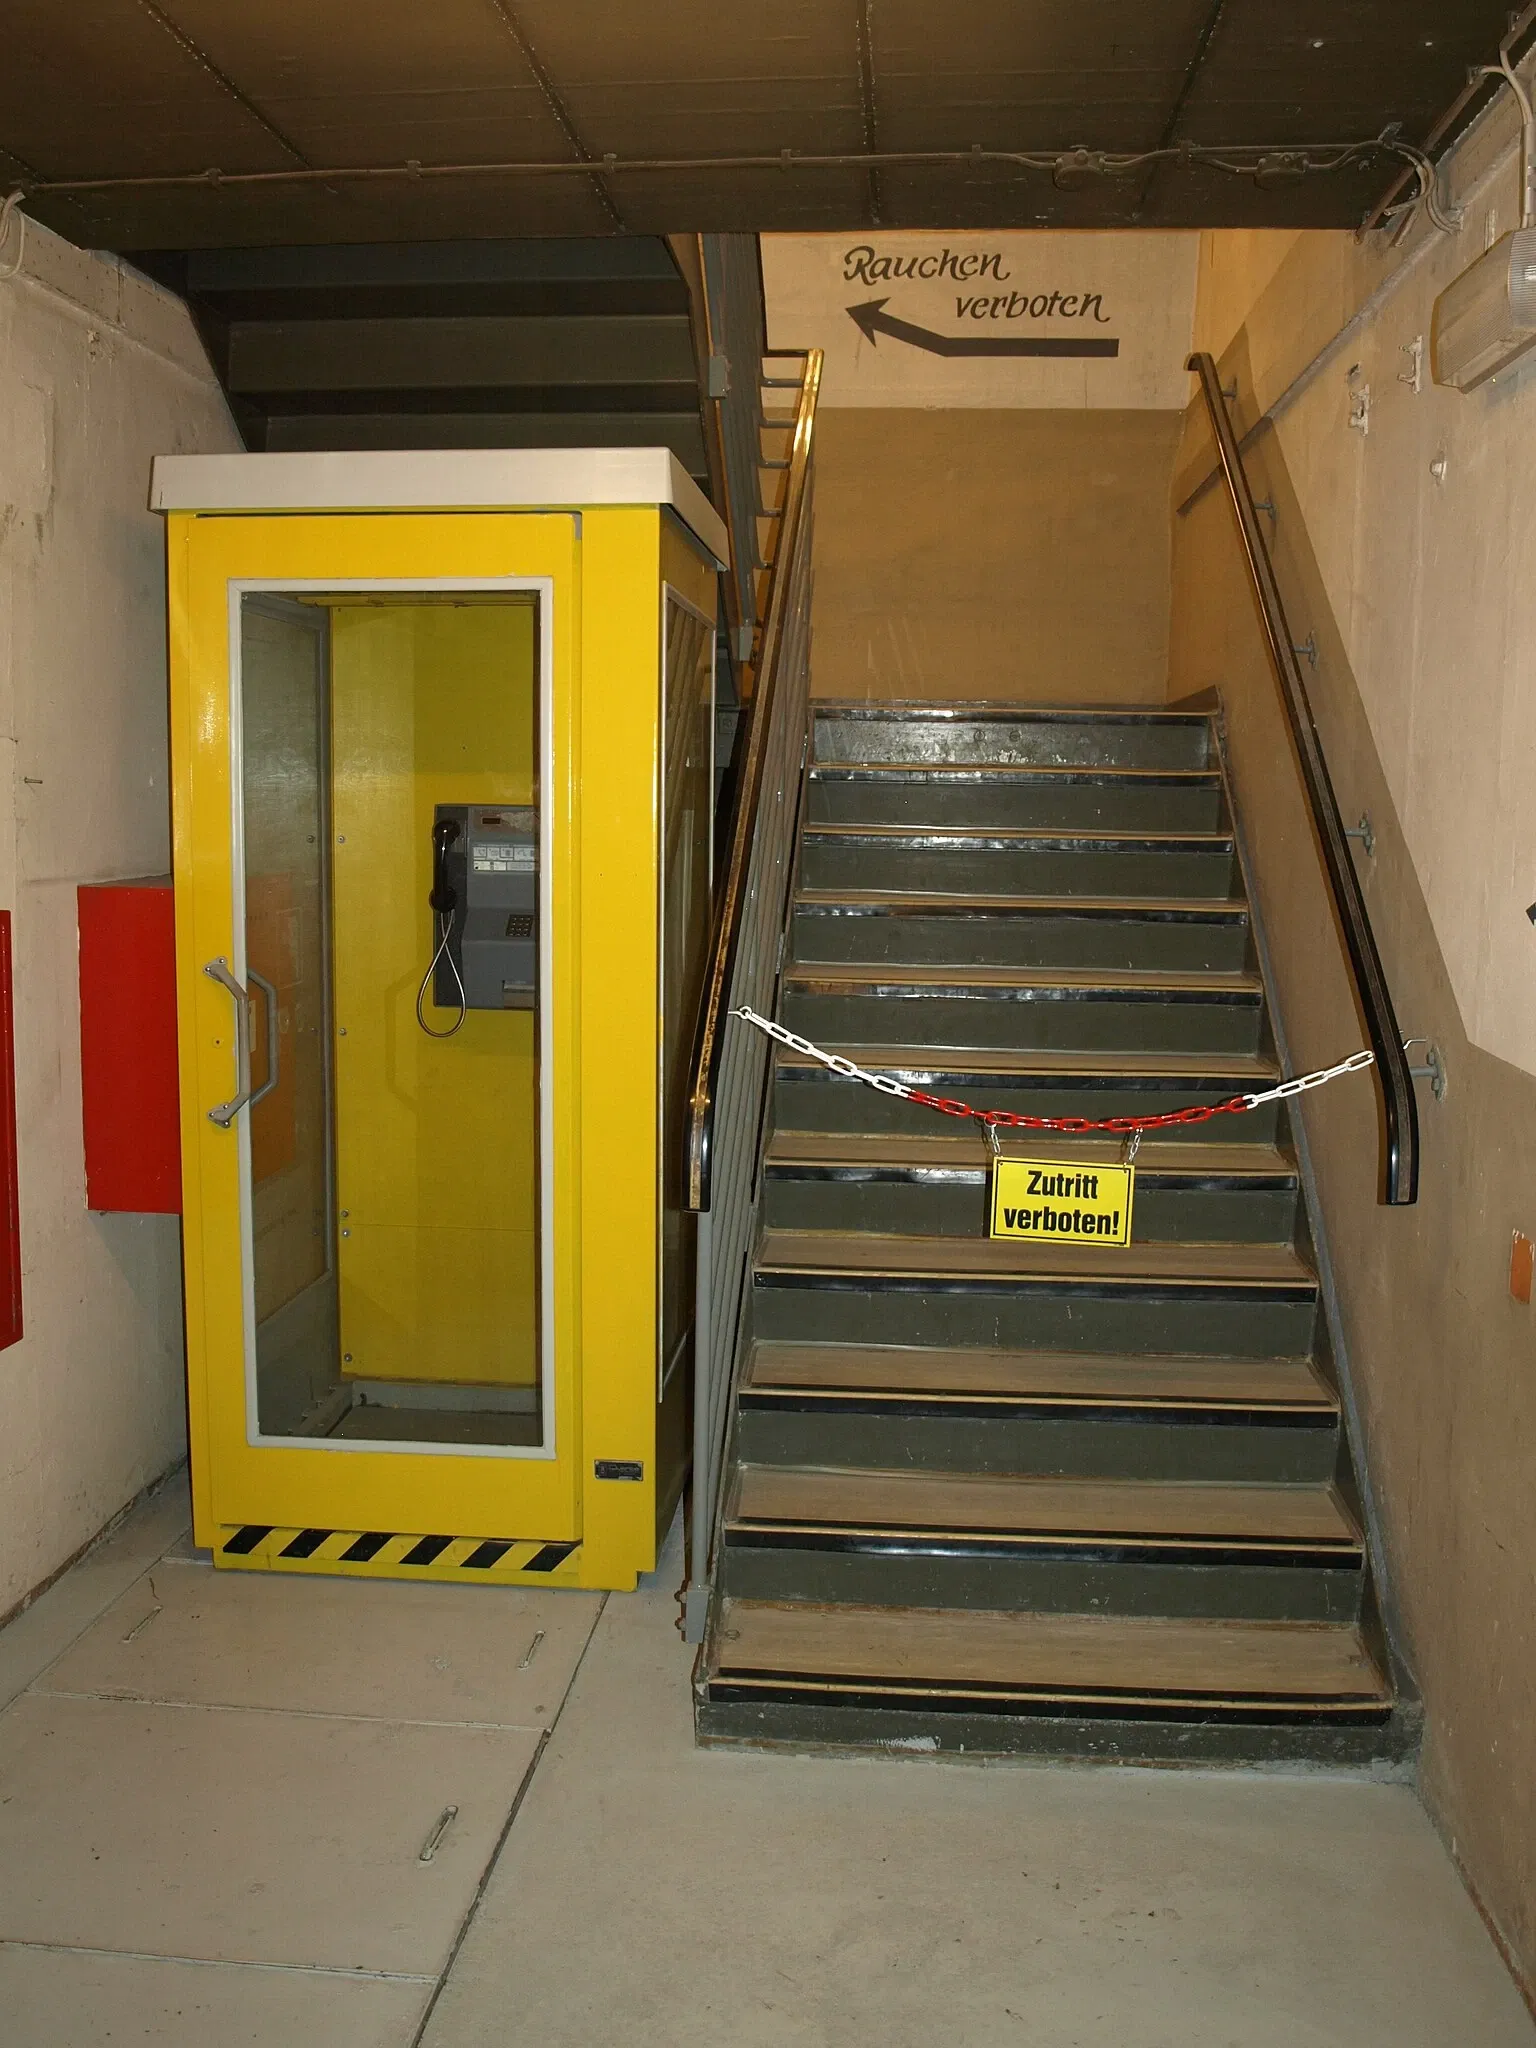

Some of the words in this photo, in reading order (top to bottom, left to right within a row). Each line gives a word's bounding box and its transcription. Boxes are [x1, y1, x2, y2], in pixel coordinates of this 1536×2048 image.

[843, 245, 1011, 286] Rauchen
[955, 290, 1111, 323] verboten
[1026, 1169, 1099, 1199] Zutritt
[1003, 1206, 1120, 1236] verboten!
